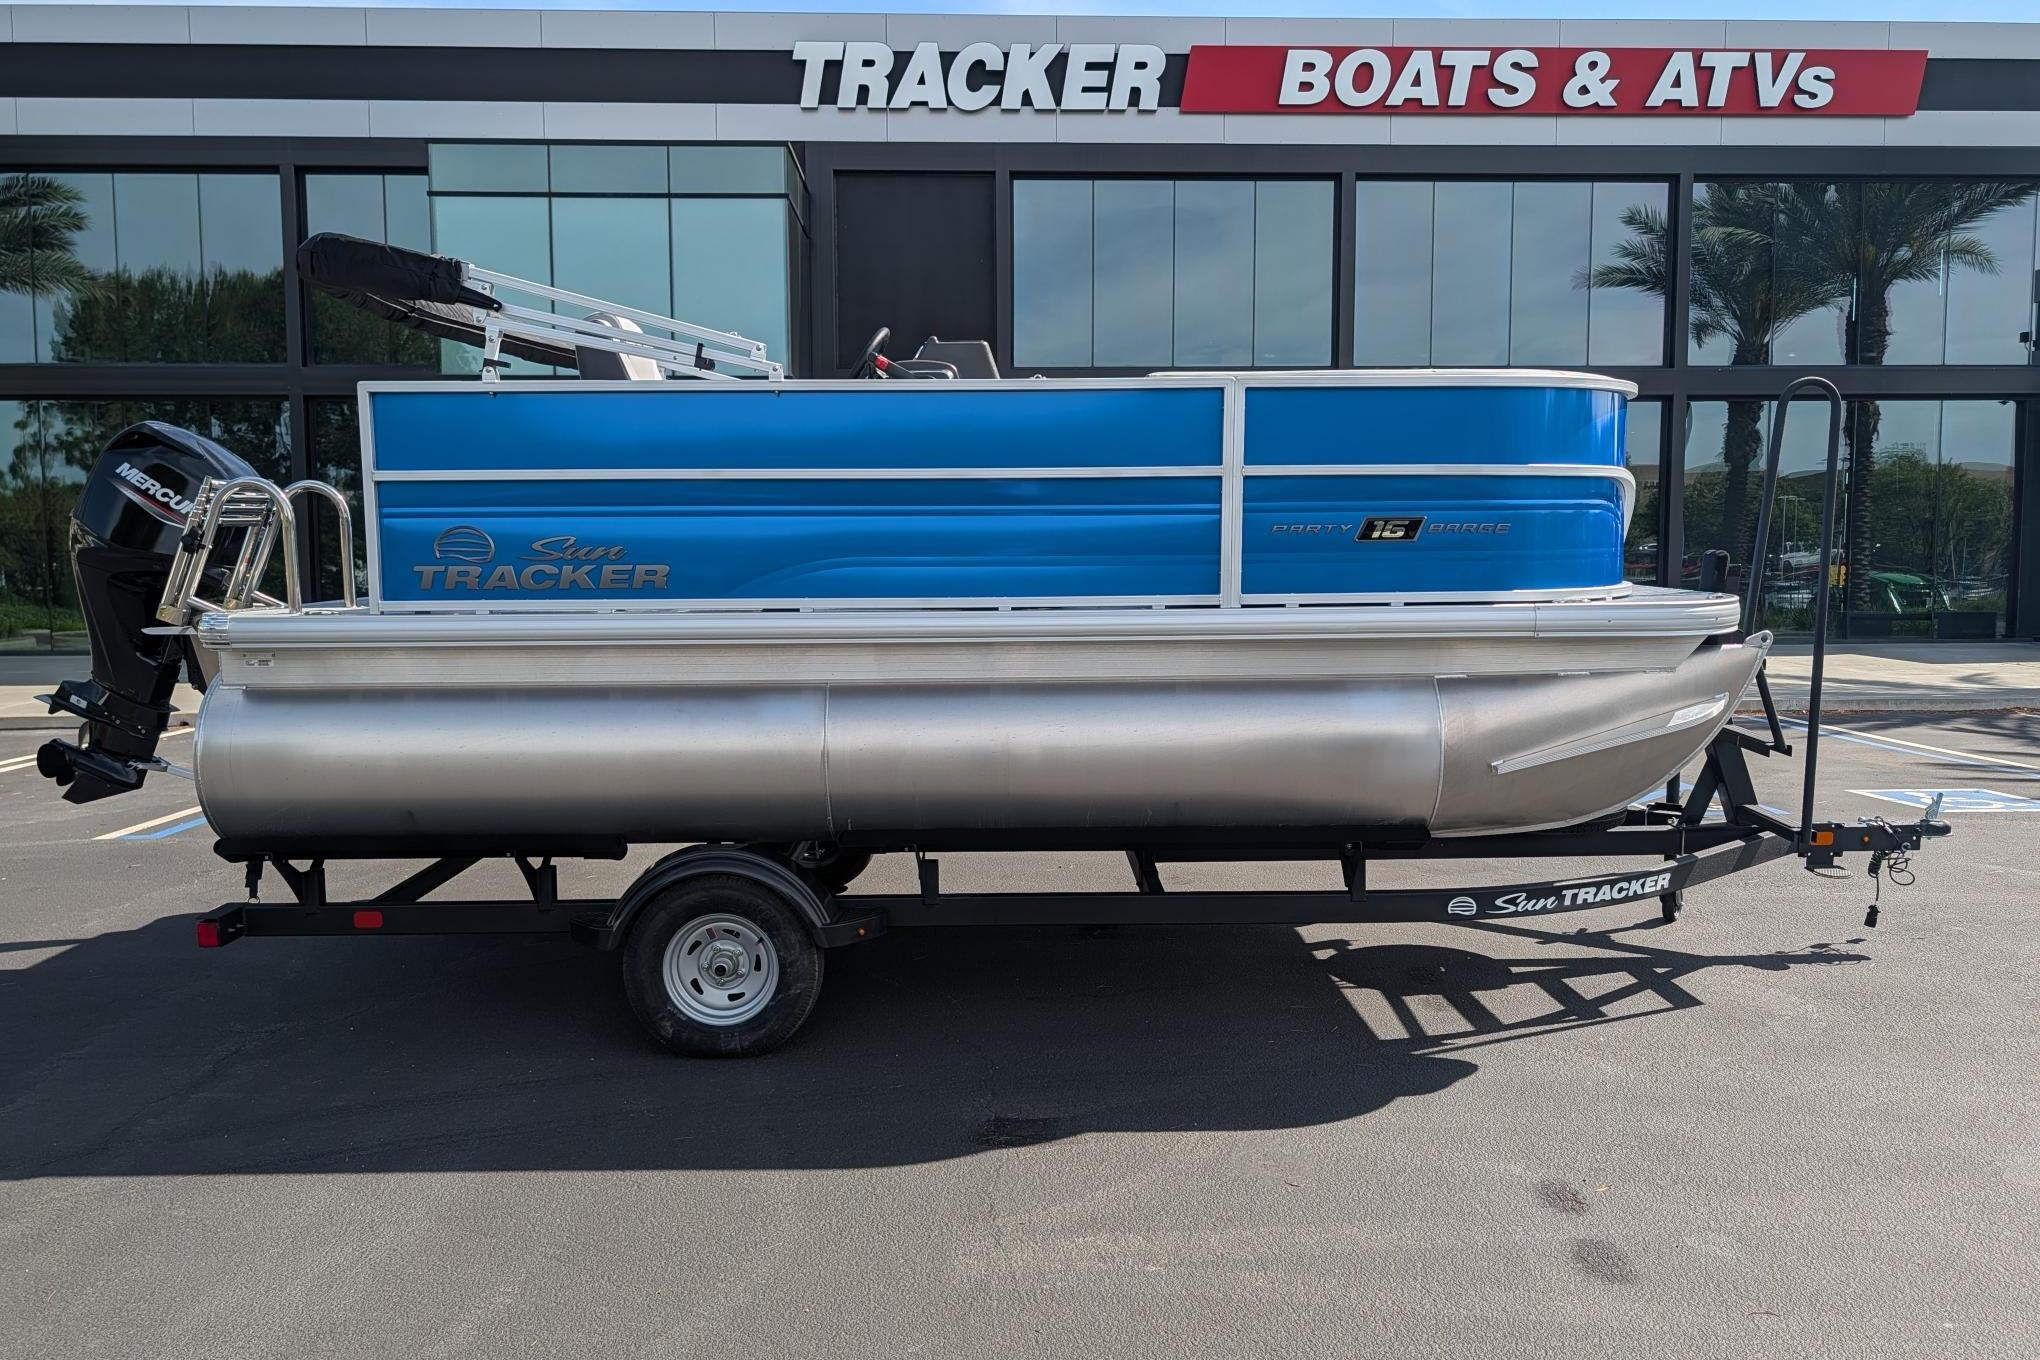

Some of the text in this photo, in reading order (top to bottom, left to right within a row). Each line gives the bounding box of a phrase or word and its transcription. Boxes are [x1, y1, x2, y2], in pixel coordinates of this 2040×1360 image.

[791, 41, 1836, 111] TRACKER BOATS & ATVs
[114, 461, 196, 515] MERCU
[1270, 519, 1512, 540] PARTY 16 BARGE
[519, 534, 628, 563] Sun
[412, 563, 671, 591] TRACKER
[1485, 872, 1672, 915] Sun TRACKER
